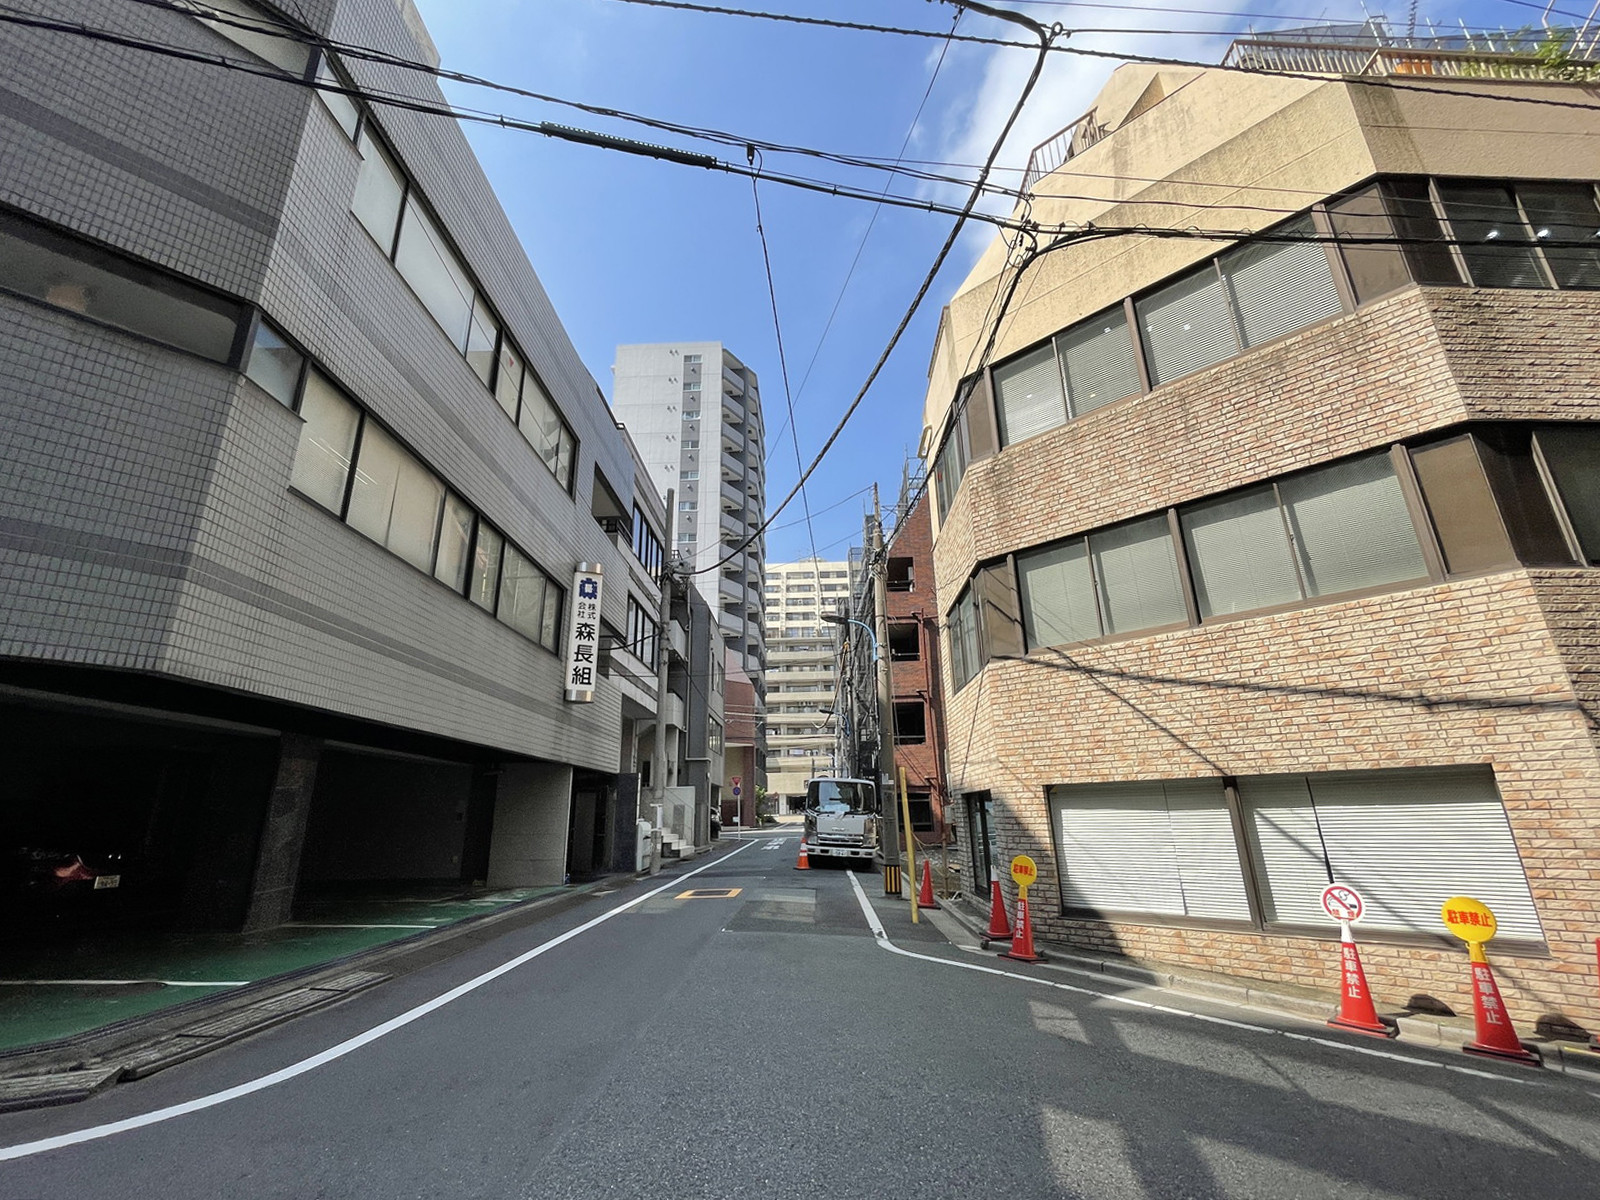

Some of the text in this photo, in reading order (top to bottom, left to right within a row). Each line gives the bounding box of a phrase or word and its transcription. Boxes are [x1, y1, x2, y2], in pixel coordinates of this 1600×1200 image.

[571, 622, 596, 686] 森長組
[1446, 909, 1493, 928] 駐車禁止
[1343, 947, 1362, 999] 駐車禁止
[1474, 967, 1503, 1026] 駐車禁止
